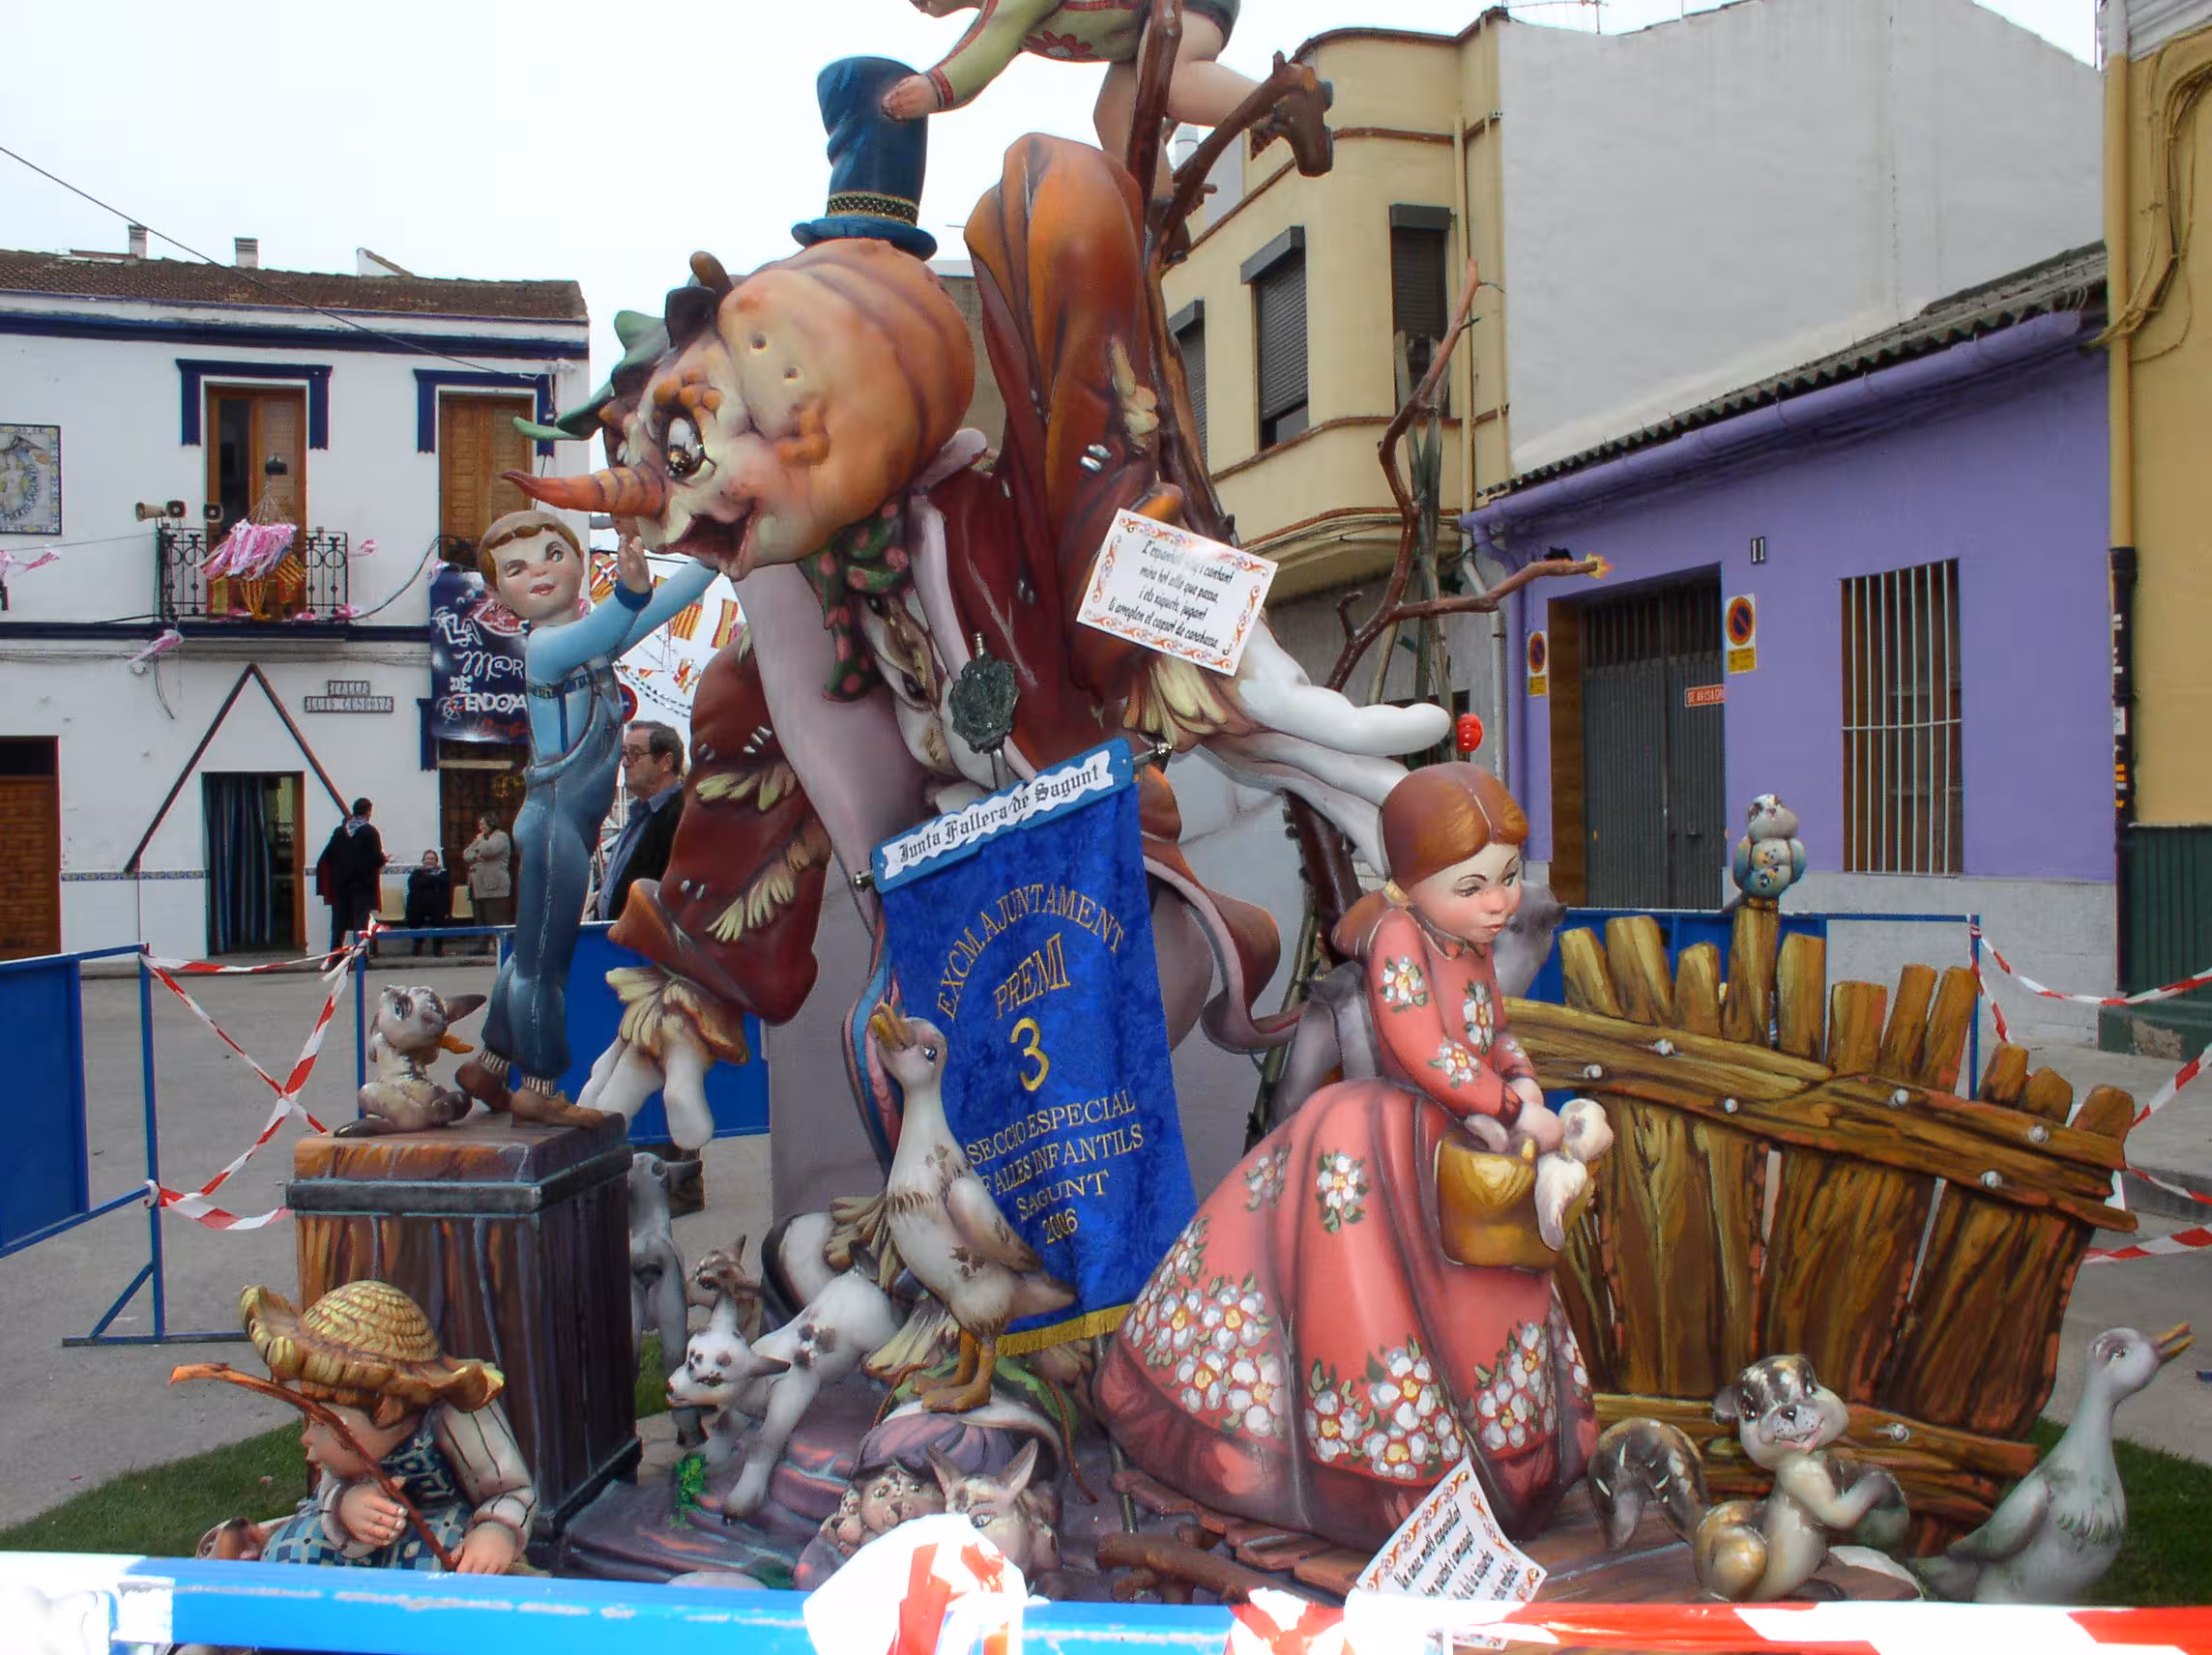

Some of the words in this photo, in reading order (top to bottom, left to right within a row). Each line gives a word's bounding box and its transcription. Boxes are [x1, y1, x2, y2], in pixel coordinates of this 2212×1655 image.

[1752, 537, 1765, 564] 11
[450, 675, 473, 693] DE
[898, 830, 941, 863] Junta
[944, 804, 1007, 846] Fallera
[1006, 791, 1030, 815] de
[1033, 763, 1099, 802] Sagunt
[980, 884, 1125, 954] AJUNTAMENT
[993, 932, 1071, 1018] PREMI
[1009, 1017, 1050, 1091] 3
[967, 1121, 1027, 1165] SECCIO
[1026, 1089, 1136, 1139] ESPECIAL
[1016, 1169, 1110, 1221] SAGUNT
[1042, 1207, 1078, 1244] 2006
